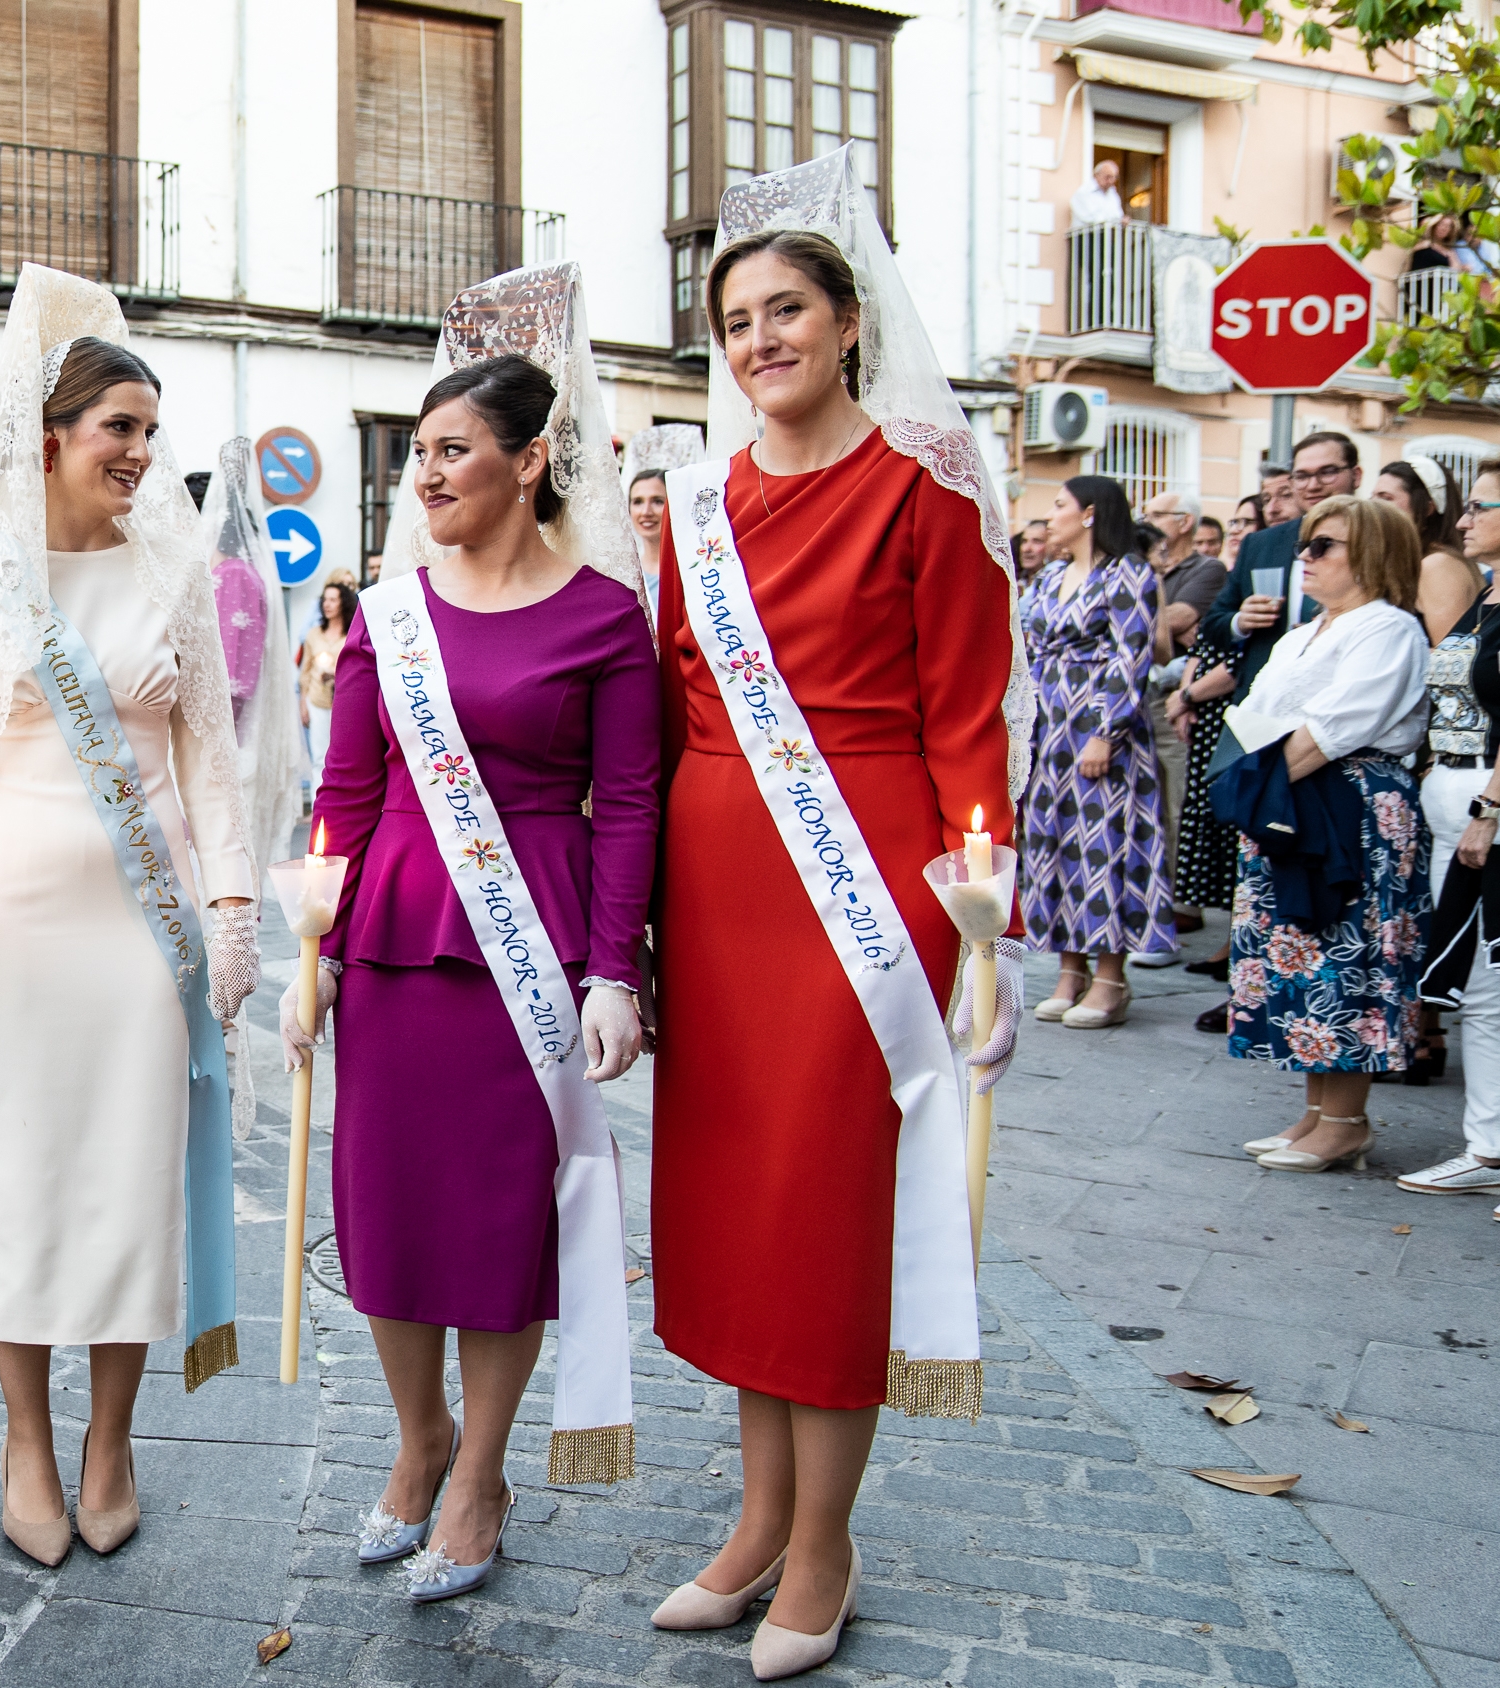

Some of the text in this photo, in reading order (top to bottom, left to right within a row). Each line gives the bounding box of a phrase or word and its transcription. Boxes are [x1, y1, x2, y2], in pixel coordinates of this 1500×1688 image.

[1215, 294, 1367, 339] STOP
[700, 569, 744, 658] DAMA
[742, 685, 779, 731] DE
[402, 671, 449, 760] DAMA
[445, 788, 481, 833] DE
